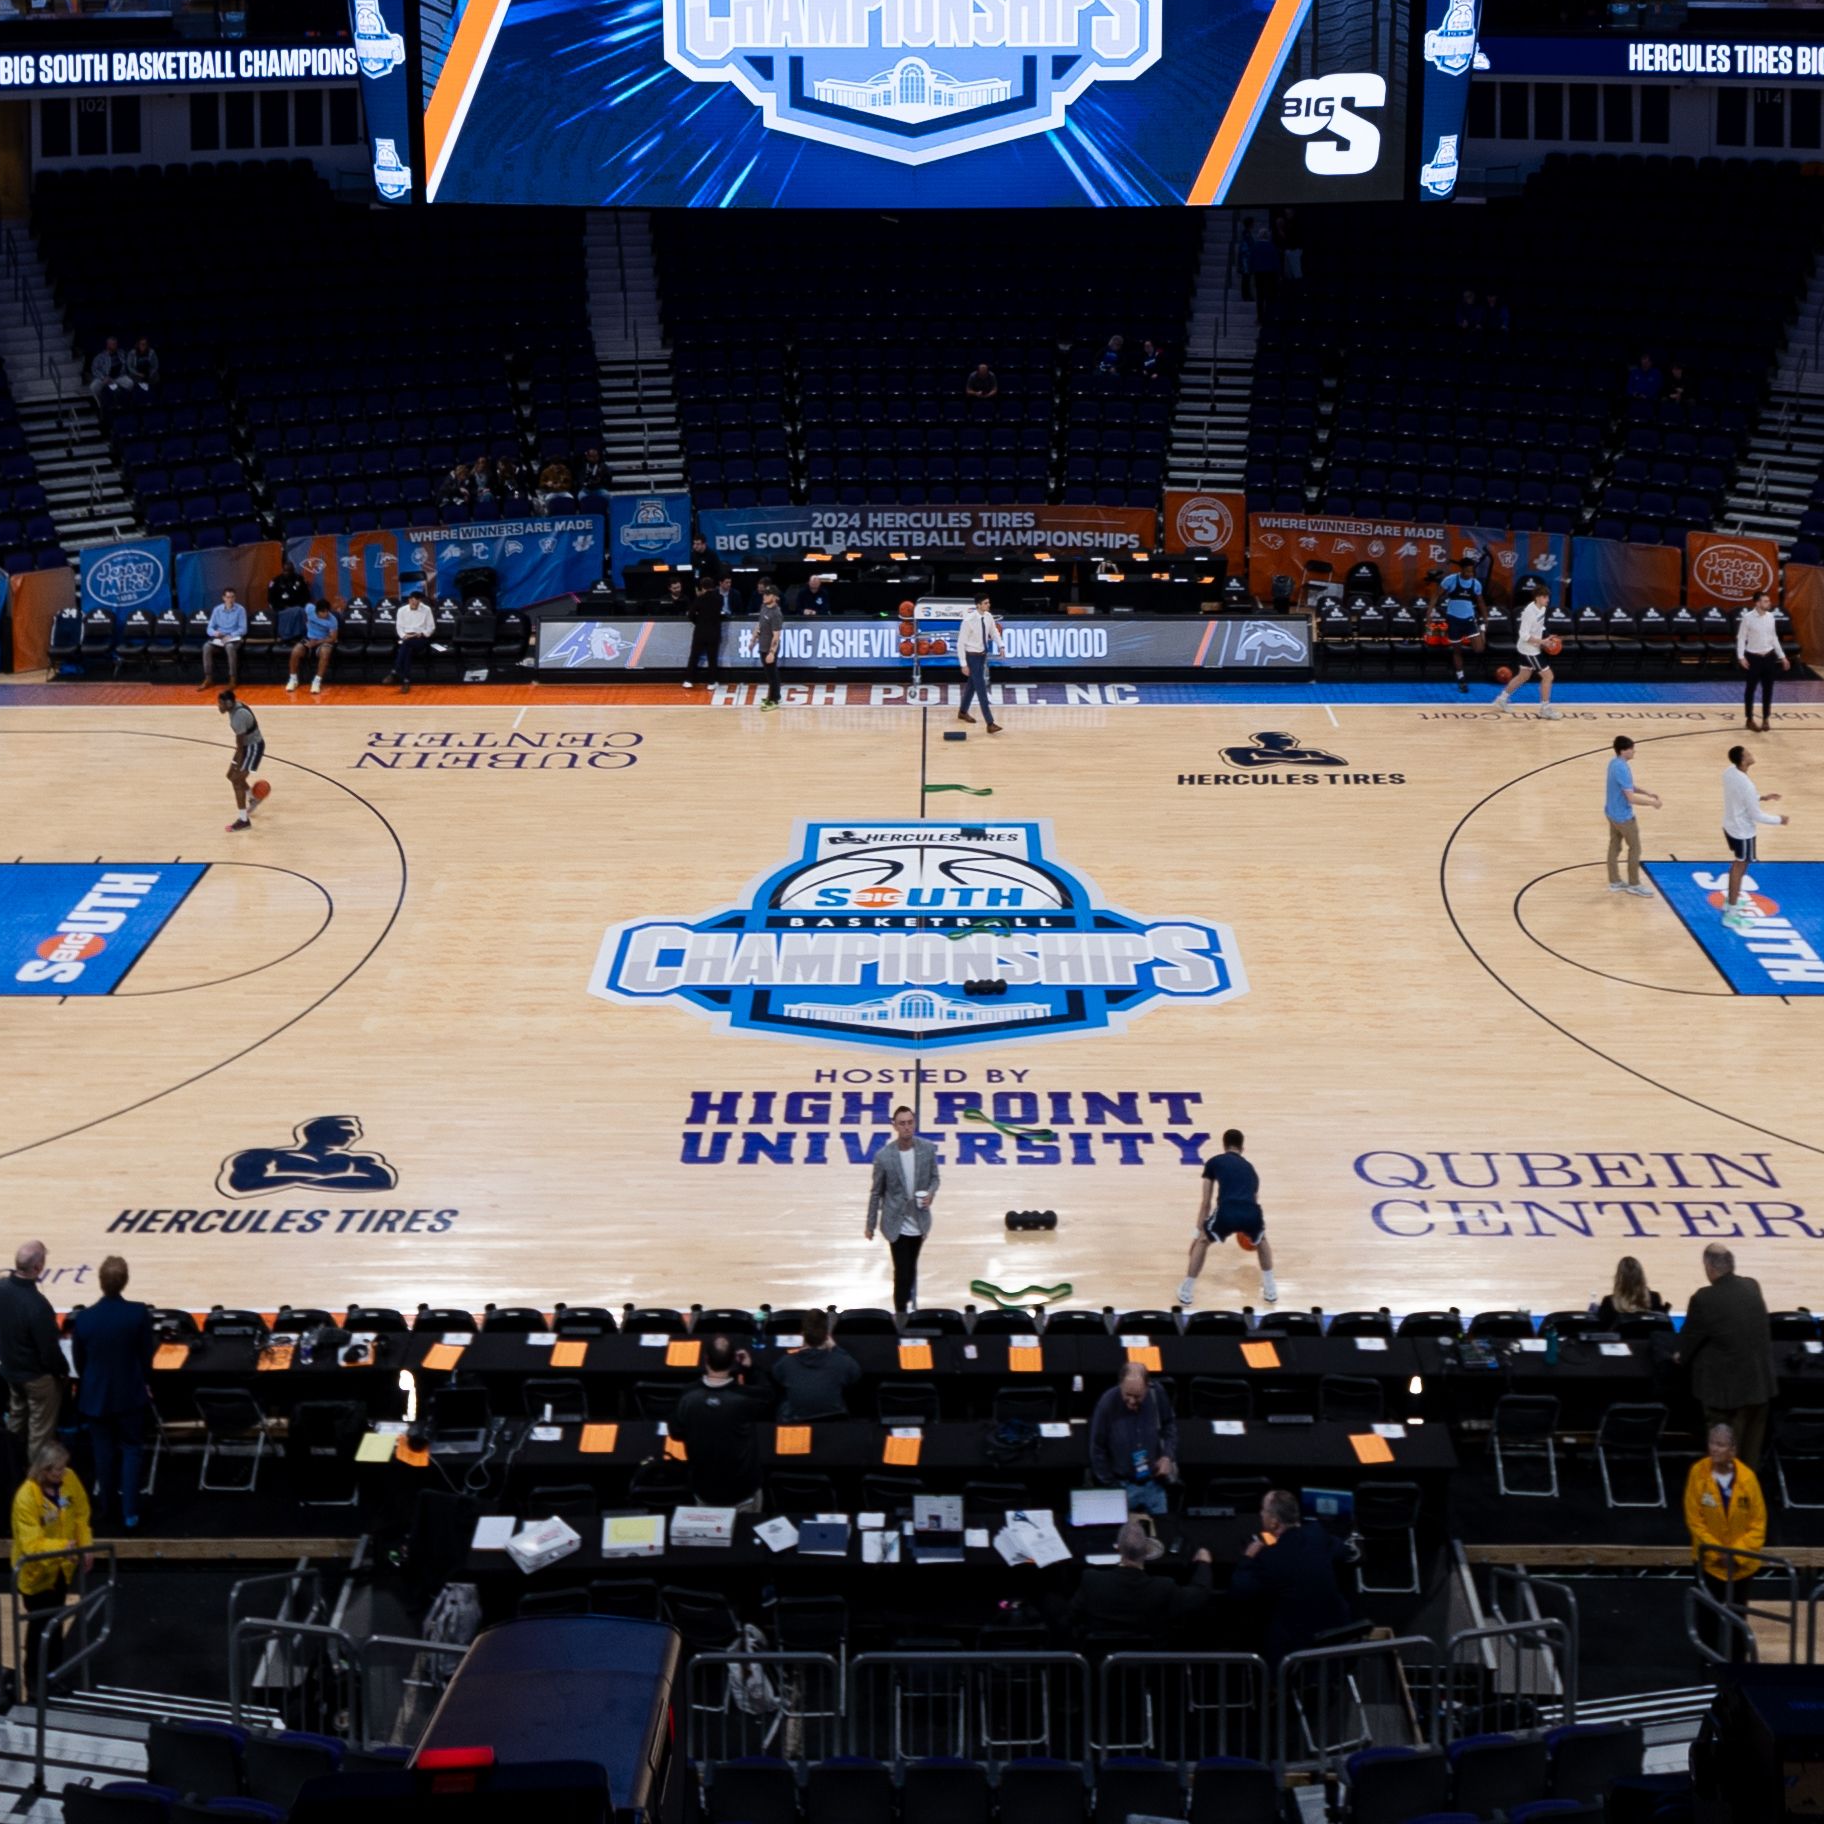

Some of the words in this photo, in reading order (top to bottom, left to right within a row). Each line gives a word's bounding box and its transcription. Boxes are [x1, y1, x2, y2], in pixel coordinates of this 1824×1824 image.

[0, 54, 36, 86] BIG
[39, 53, 109, 84] SOUTH
[112, 50, 236, 81] BASKETBALL
[1628, 42, 1731, 73] HERCULES
[1734, 44, 1793, 75] TIRES
[78, 98, 108, 113] 102
[1281, 95, 1336, 122] BIG
[409, 529, 458, 544] WHERE
[461, 524, 524, 539] WINNERS
[525, 521, 553, 535] ARE
[556, 518, 594, 533] MADE
[811, 511, 863, 528] 2024
[868, 511, 973, 529] HERCULES
[978, 511, 1036, 528] TIRES
[1259, 517, 1307, 530] WHERE
[1310, 520, 1371, 535] WINNERS
[1374, 525, 1401, 538] ARE
[1404, 526, 1445, 540] MADE
[715, 534, 752, 551] BIG
[756, 531, 824, 549] SOUTH
[832, 530, 966, 548] BASKETBALL
[971, 530, 1140, 549] CHAMPIONSHIPS
[97, 561, 153, 577] Jersey
[1703, 552, 1762, 574] Jersey
[1065, 683, 1140, 706] NC
[368, 732, 645, 749] CENTER
[348, 752, 639, 771] QUBEIN
[1177, 772, 1320, 787] HERCULES
[1323, 772, 1407, 786] TIRES
[866, 832, 960, 844] HERCULES
[617, 922, 1222, 995] CHAMPIONSHIPS
[814, 1068, 969, 1084] HOSTED
[986, 1068, 1031, 1084] BY
[684, 1090, 900, 1126] HIGH
[934, 1090, 1204, 1126] POINT
[1351, 1150, 1782, 1193] QUBEIN
[106, 1207, 332, 1236] HERCULES
[338, 1207, 461, 1235] TIRES
